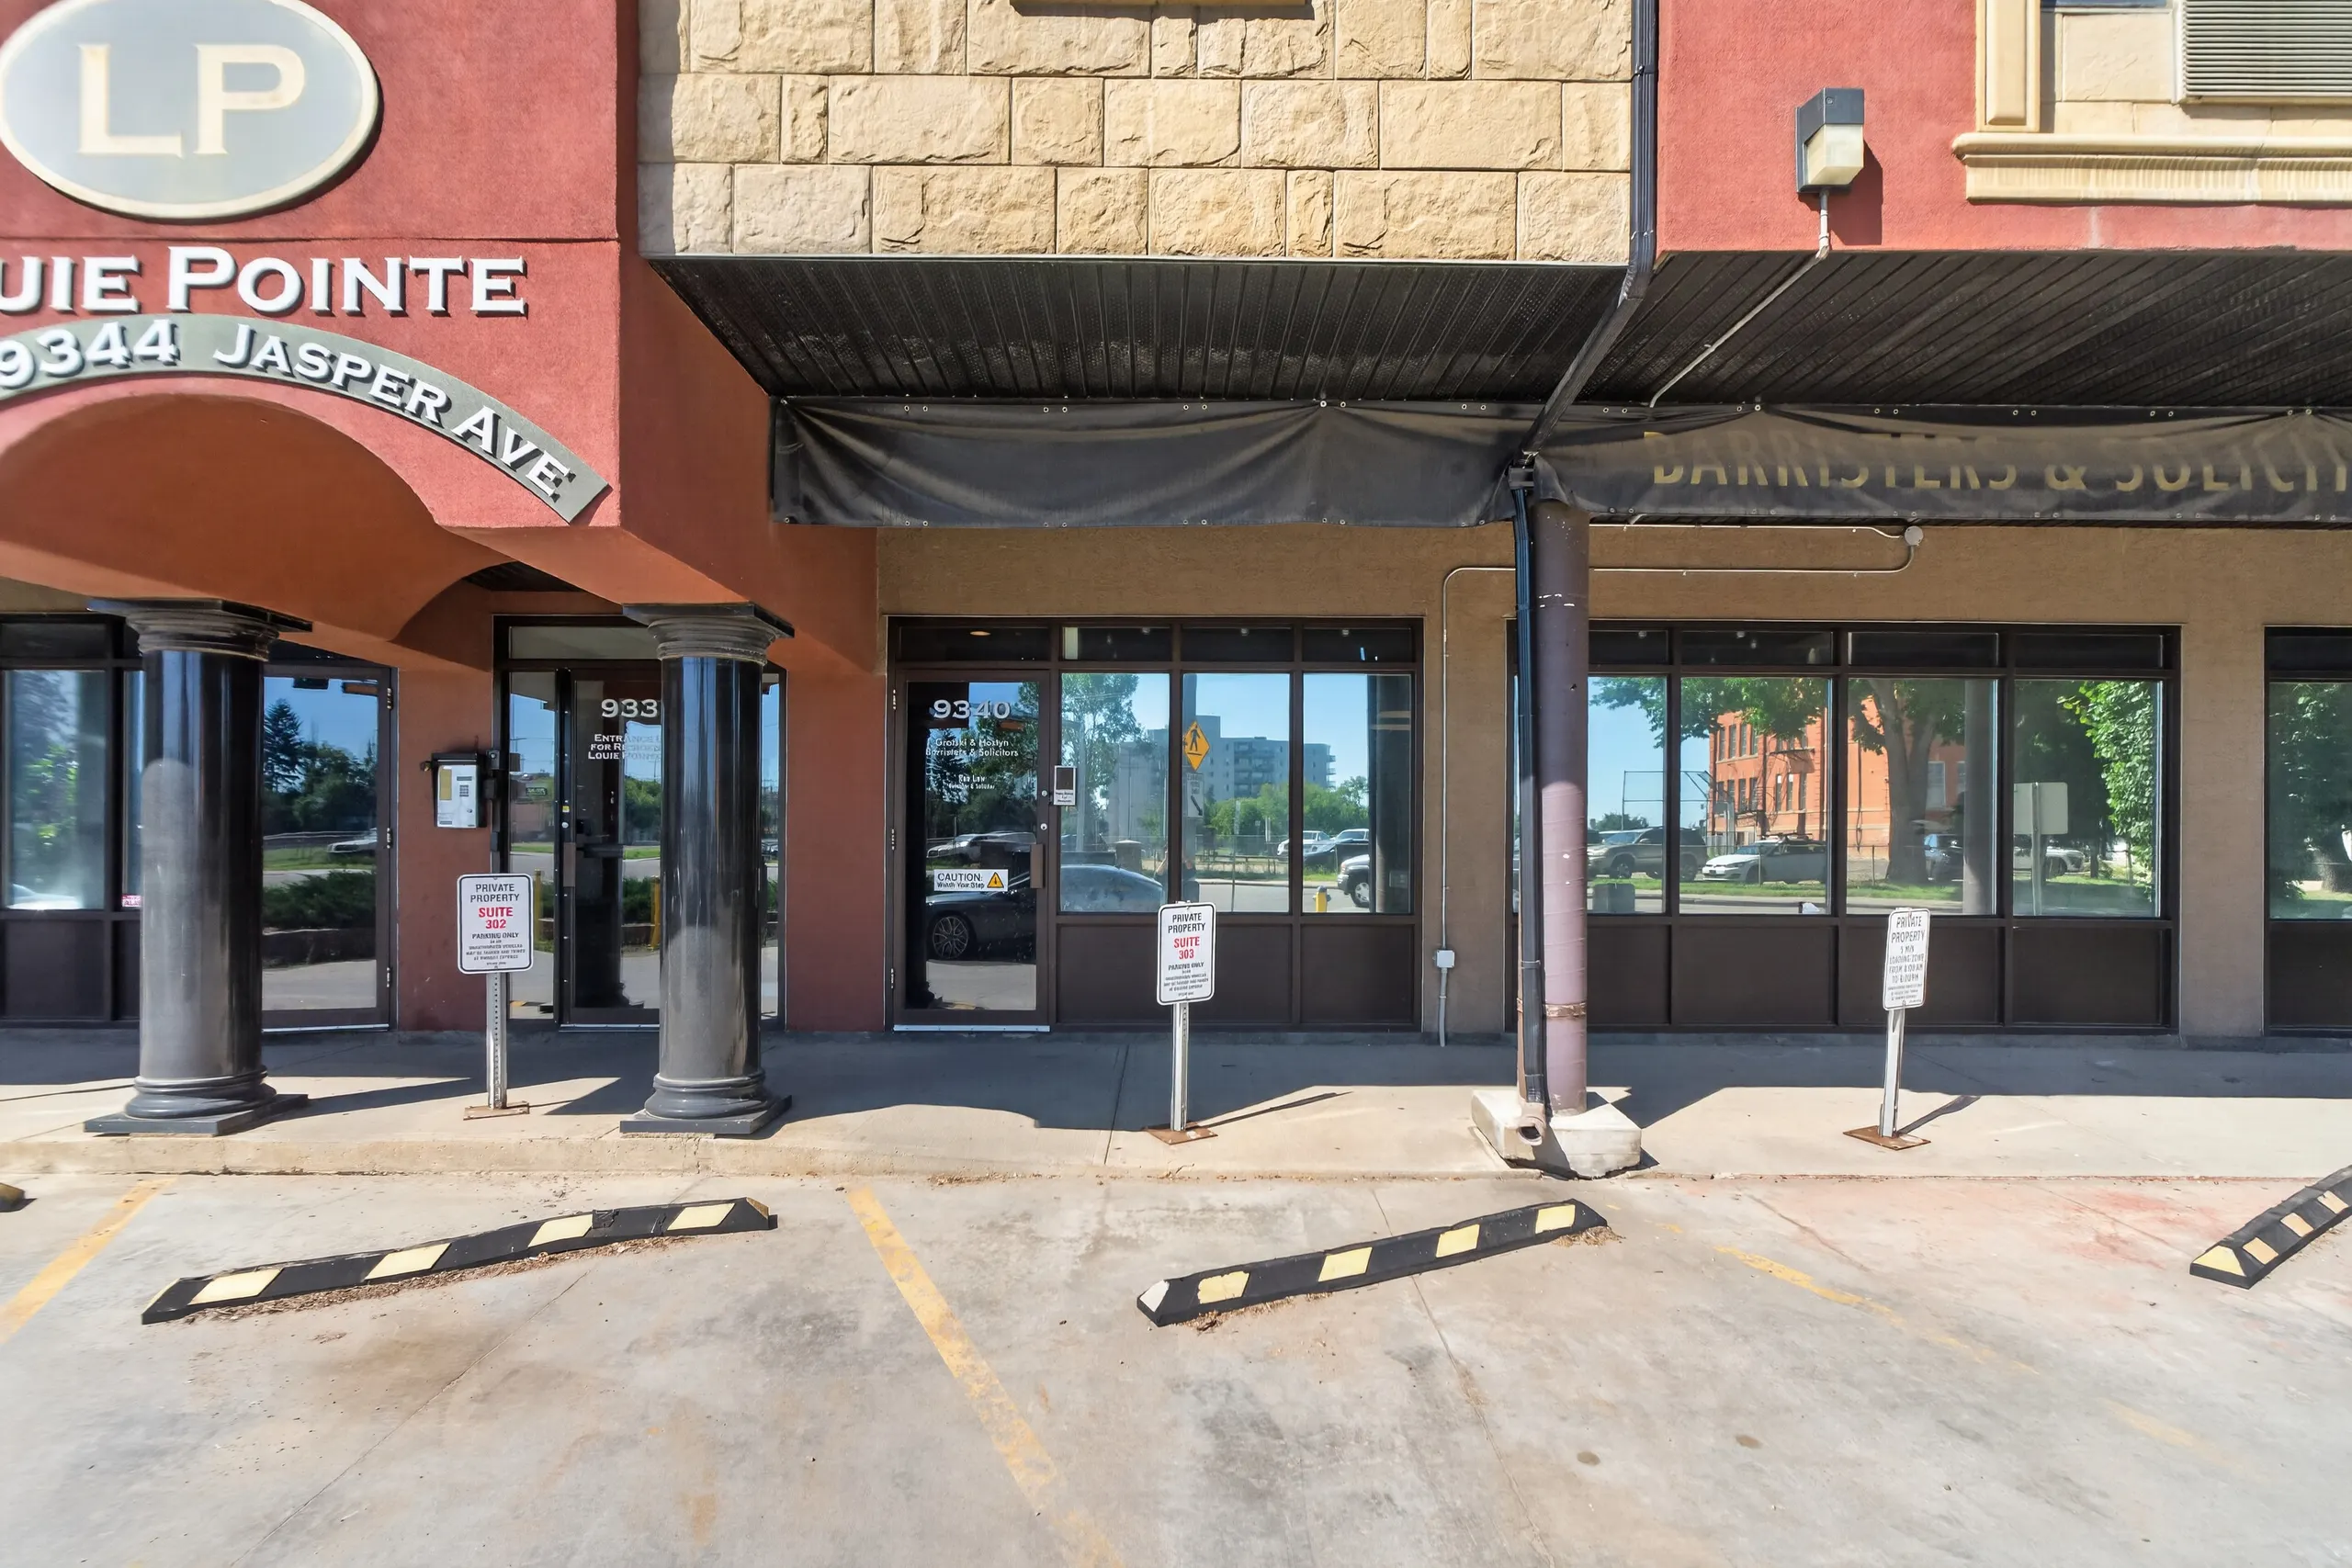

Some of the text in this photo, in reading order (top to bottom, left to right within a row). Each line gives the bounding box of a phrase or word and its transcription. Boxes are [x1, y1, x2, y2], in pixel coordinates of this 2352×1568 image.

[76, 44, 305, 159] LP
[166, 246, 526, 314] POINTE
[0, 319, 572, 498] 9344 JASPER AVE
[933, 699, 1011, 719] 9340
[979, 748, 1019, 757] Solicitors
[937, 872, 983, 882] CAUTION:
[475, 884, 515, 893] PRIVATE
[970, 882, 985, 890] Step
[469, 894, 520, 903] PROPERTY
[478, 907, 514, 918] SUITE
[1172, 912, 1202, 923] PRIVATE
[485, 919, 507, 930] 302
[1168, 922, 1205, 933] PROPERTY
[1896, 916, 1922, 928] PRIVATE
[1173, 936, 1200, 948] SUITE
[1891, 930, 1926, 943] PROPERTY
[1179, 949, 1194, 960] 303
